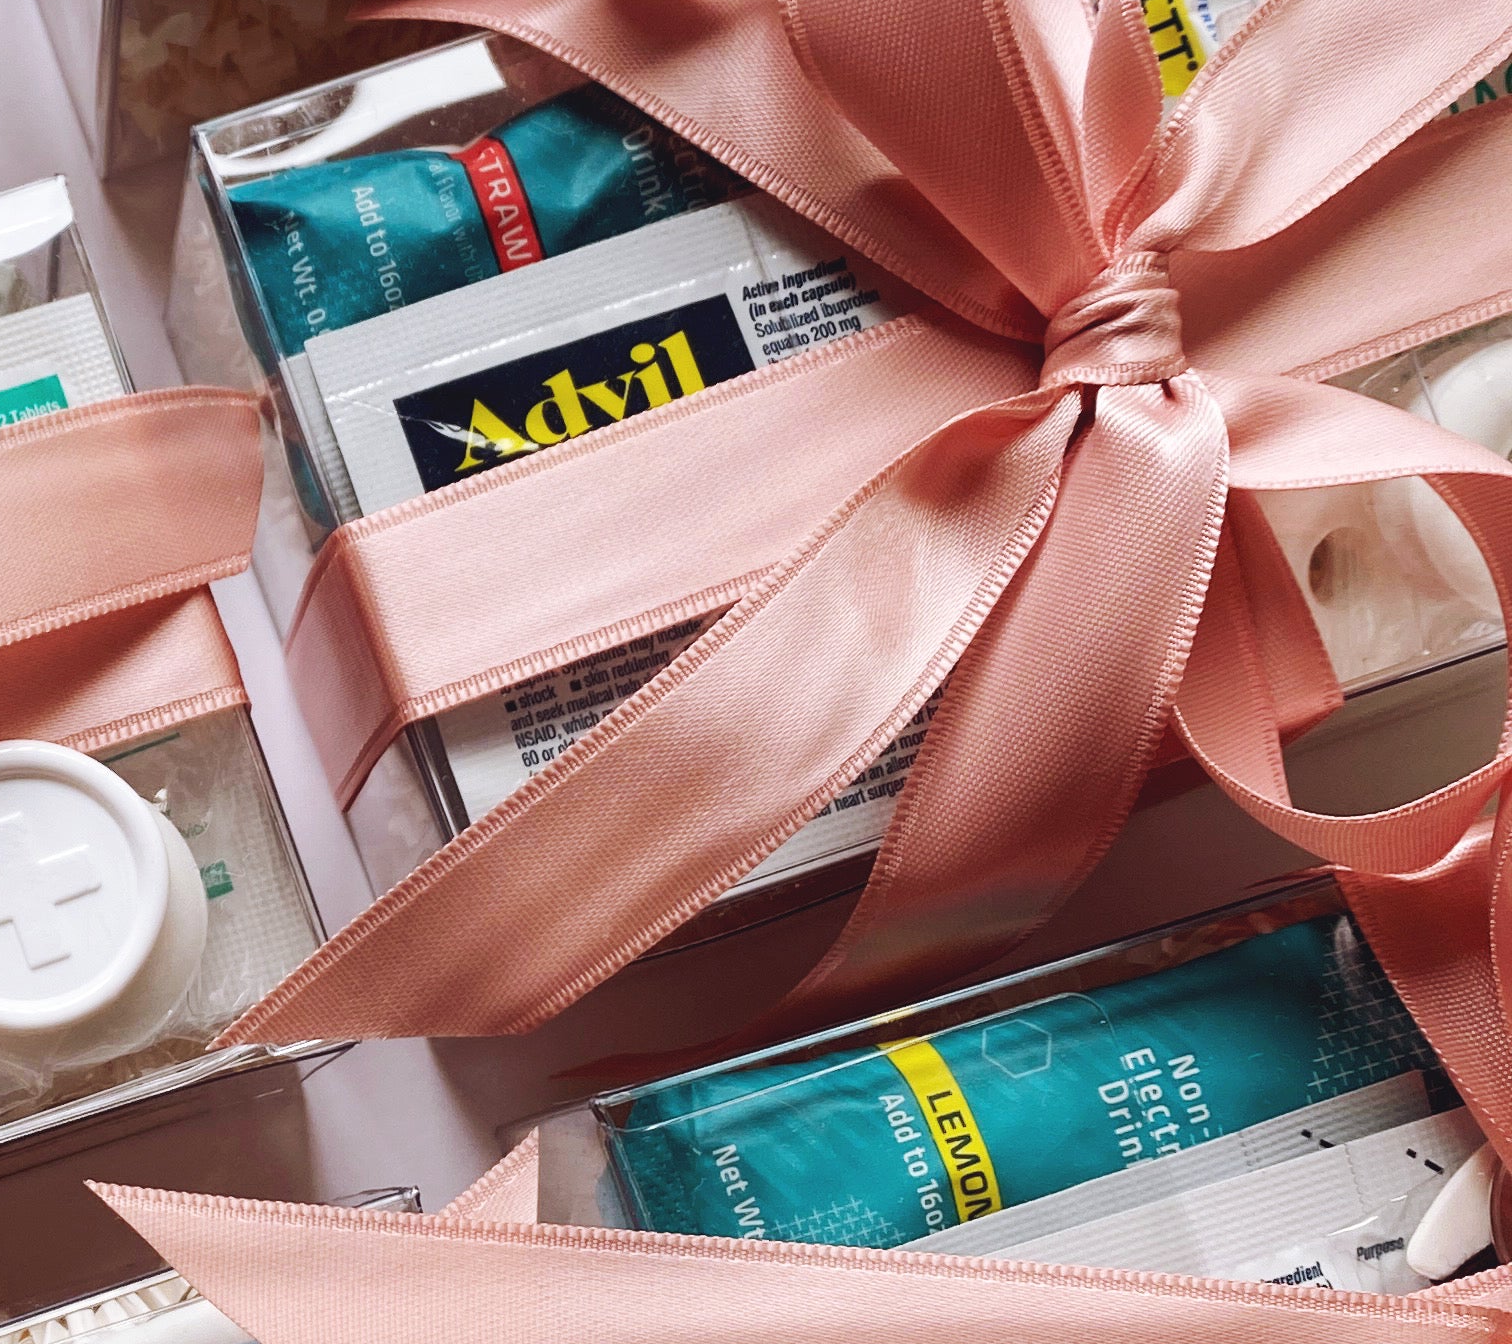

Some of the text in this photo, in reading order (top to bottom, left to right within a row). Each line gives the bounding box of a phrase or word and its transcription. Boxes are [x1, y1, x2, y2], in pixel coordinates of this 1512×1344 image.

[622, 123, 673, 216] Drink
[352, 186, 384, 226] Add
[367, 228, 388, 257] to
[293, 256, 317, 306] Wt.
[742, 257, 847, 299] Active ingredient
[748, 274, 856, 320] (in each capsule)
[821, 289, 879, 317] ibuprofen
[796, 316, 860, 344] to 200 mg
[9, 400, 61, 425] Tablets
[454, 330, 706, 472] Advil
[629, 620, 703, 654] may include:
[519, 669, 608, 705] shock skin
[510, 690, 612, 729] and seek medical
[516, 714, 597, 747] NSAID, which
[522, 747, 555, 766] 60 or
[869, 751, 918, 780] an aller
[834, 777, 906, 810] heart surger
[1122, 1048, 1183, 1157] Electr
[878, 1094, 922, 1143] Add
[903, 1146, 929, 1178] to
[1097, 1079, 1153, 1168] Drin
[712, 1144, 750, 1198] Net
[1357, 1238, 1404, 1261] Purpose
